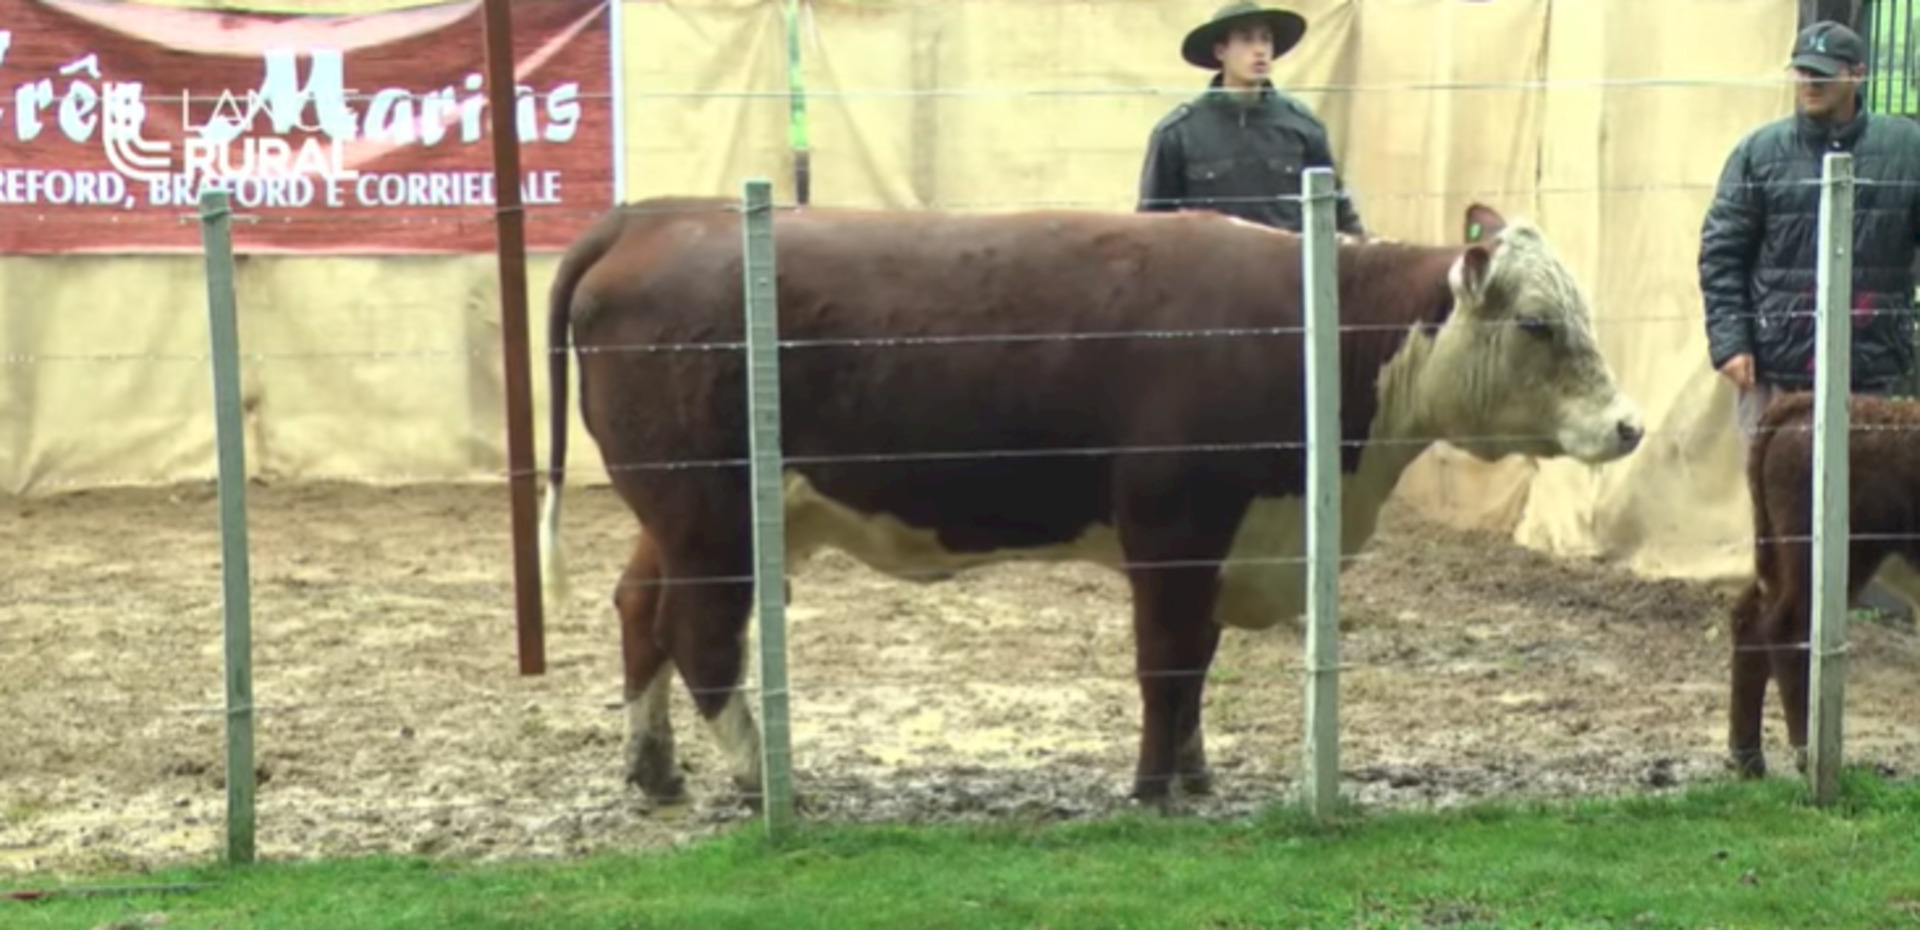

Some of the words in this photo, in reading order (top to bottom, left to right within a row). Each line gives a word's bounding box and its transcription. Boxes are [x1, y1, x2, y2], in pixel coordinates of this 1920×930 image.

[0, 30, 146, 143] rês
[0, 168, 135, 210] EFORD,
[326, 175, 345, 207] E
[355, 171, 562, 206] CORRIELE
